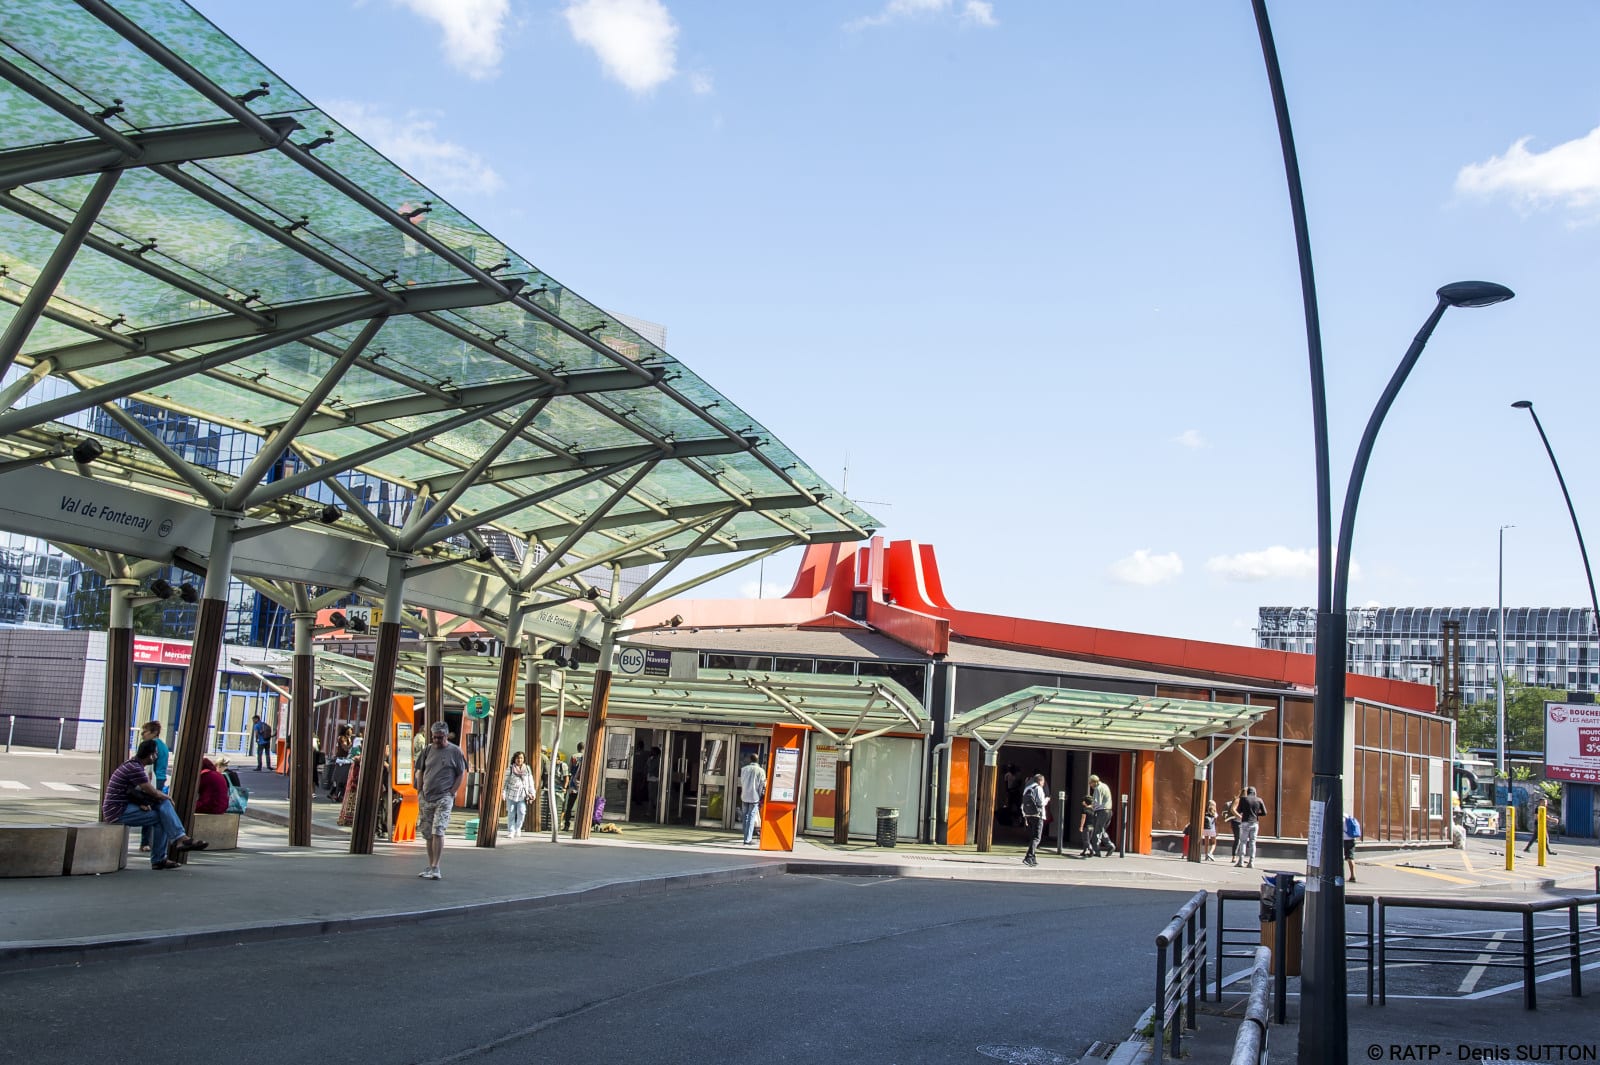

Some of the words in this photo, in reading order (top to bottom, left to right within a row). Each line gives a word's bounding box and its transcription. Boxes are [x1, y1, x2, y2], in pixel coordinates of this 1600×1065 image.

[60, 496, 82, 513] Val
[81, 502, 98, 518] de
[98, 506, 153, 532] Fontenay
[623, 655, 641, 666] BUS
[647, 656, 669, 664] Navette
